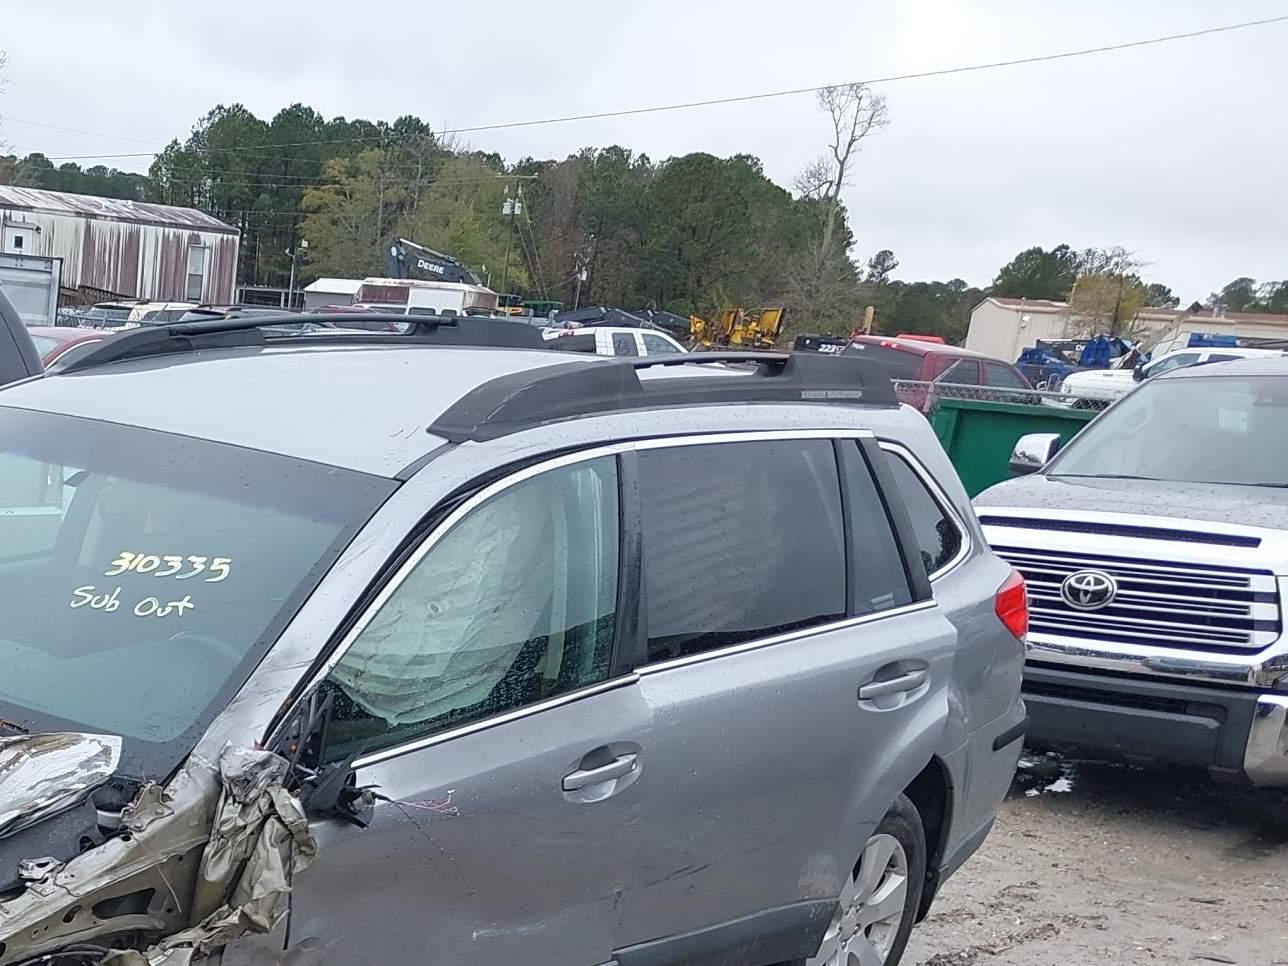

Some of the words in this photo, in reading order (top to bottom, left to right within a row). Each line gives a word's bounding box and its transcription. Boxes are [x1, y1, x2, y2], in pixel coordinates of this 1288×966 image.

[417, 259, 445, 274] DEERE
[104, 551, 232, 583] 310335
[70, 585, 122, 612] Sub
[134, 595, 195, 617] Out
